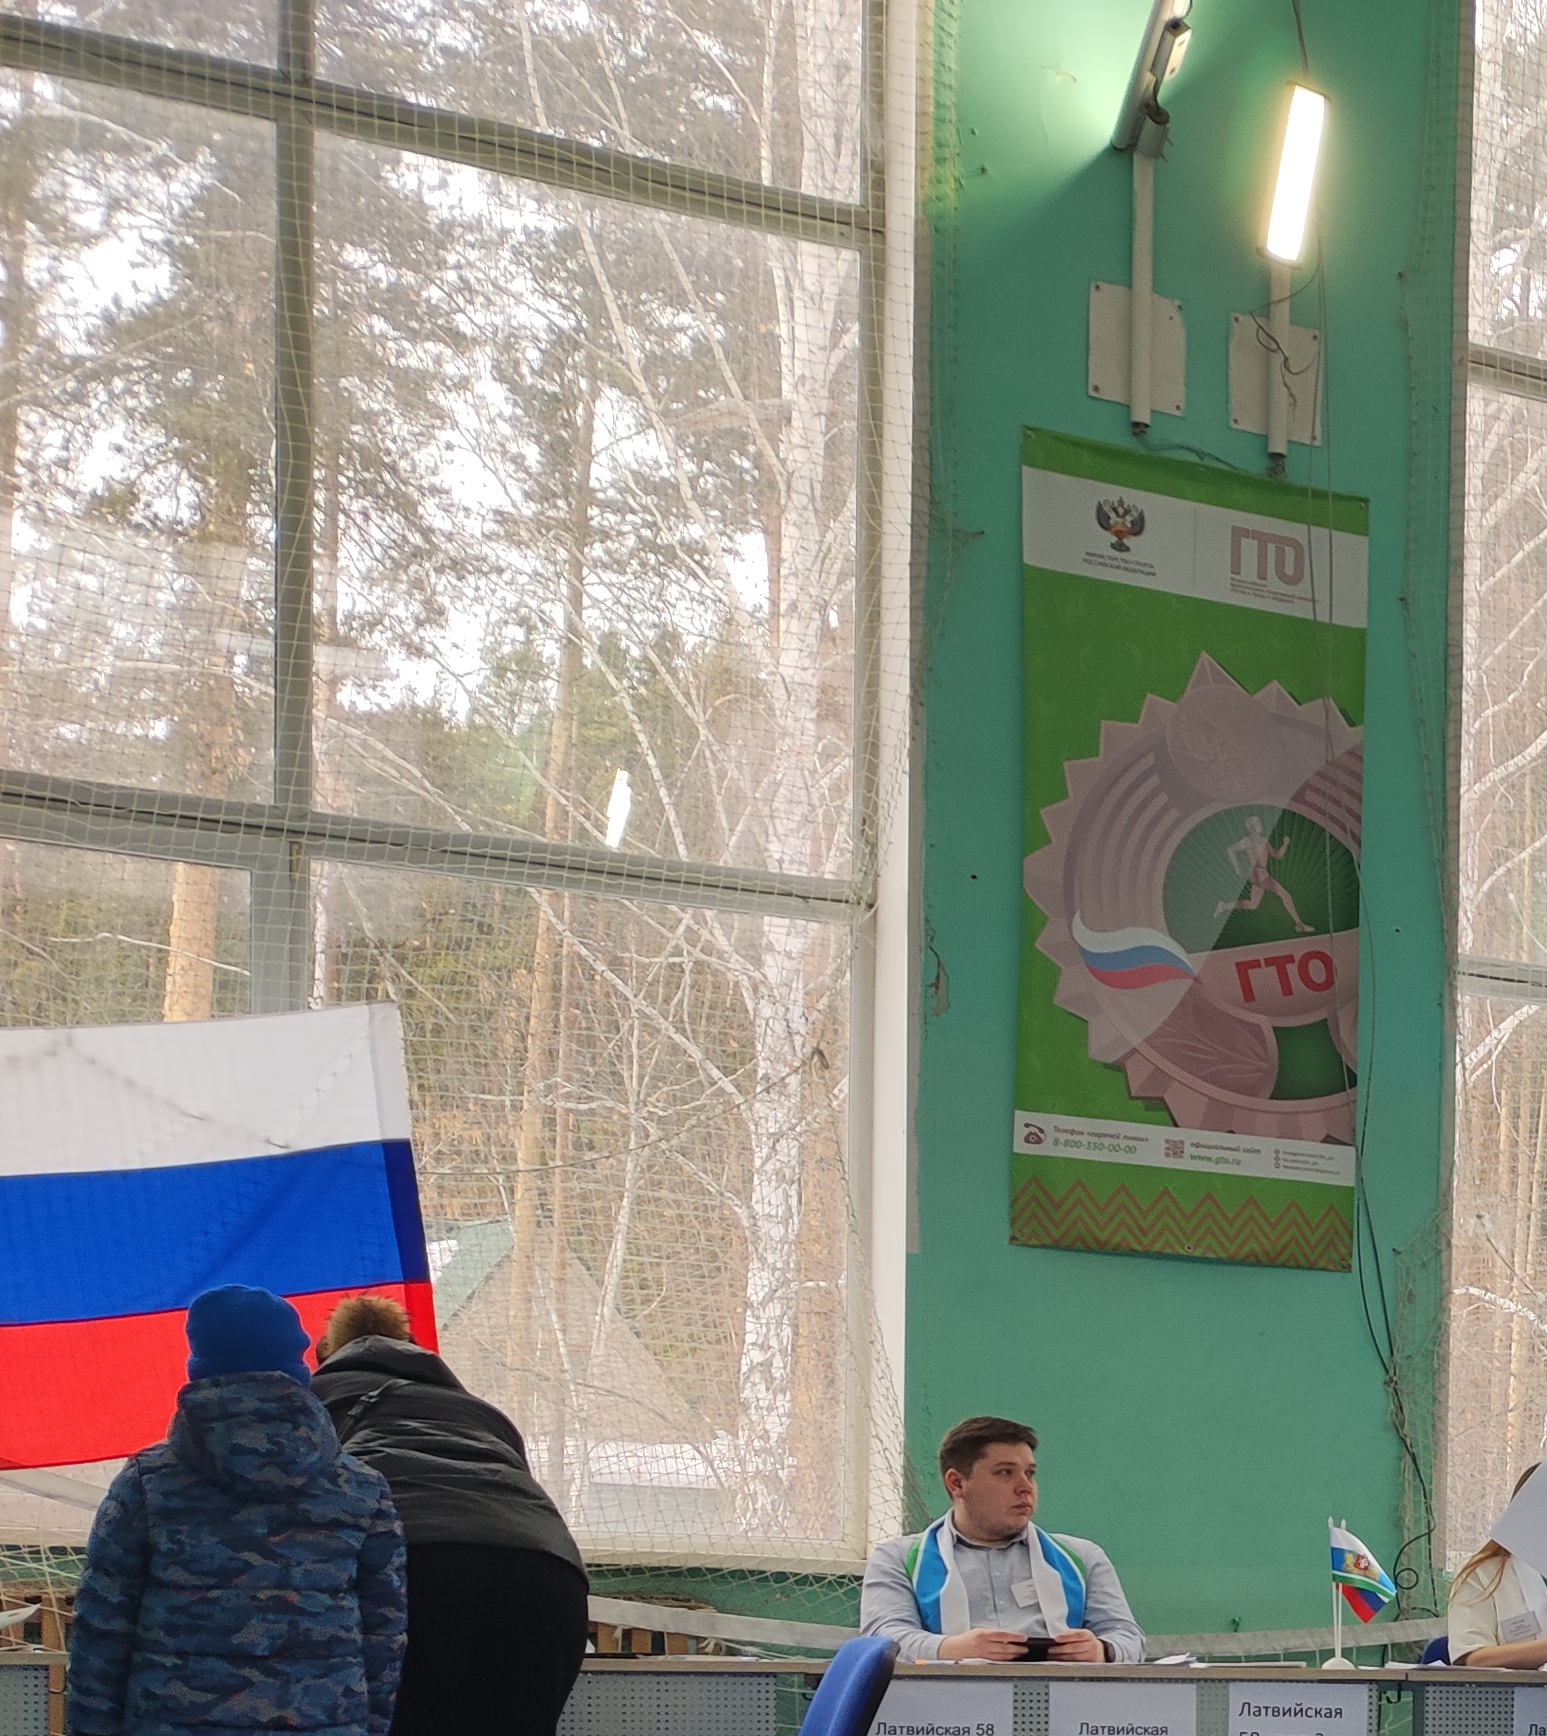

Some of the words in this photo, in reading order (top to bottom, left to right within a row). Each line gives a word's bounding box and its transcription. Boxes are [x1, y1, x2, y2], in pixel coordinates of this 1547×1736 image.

[1230, 525, 1305, 586] ГТО
[1235, 950, 1335, 1003] ГТО
[1238, 1702, 1343, 1719] Латвийская
[875, 1723, 971, 1736] Латвийская
[975, 1723, 995, 1736] 58
[1078, 1722, 1169, 1736] Латвийская
